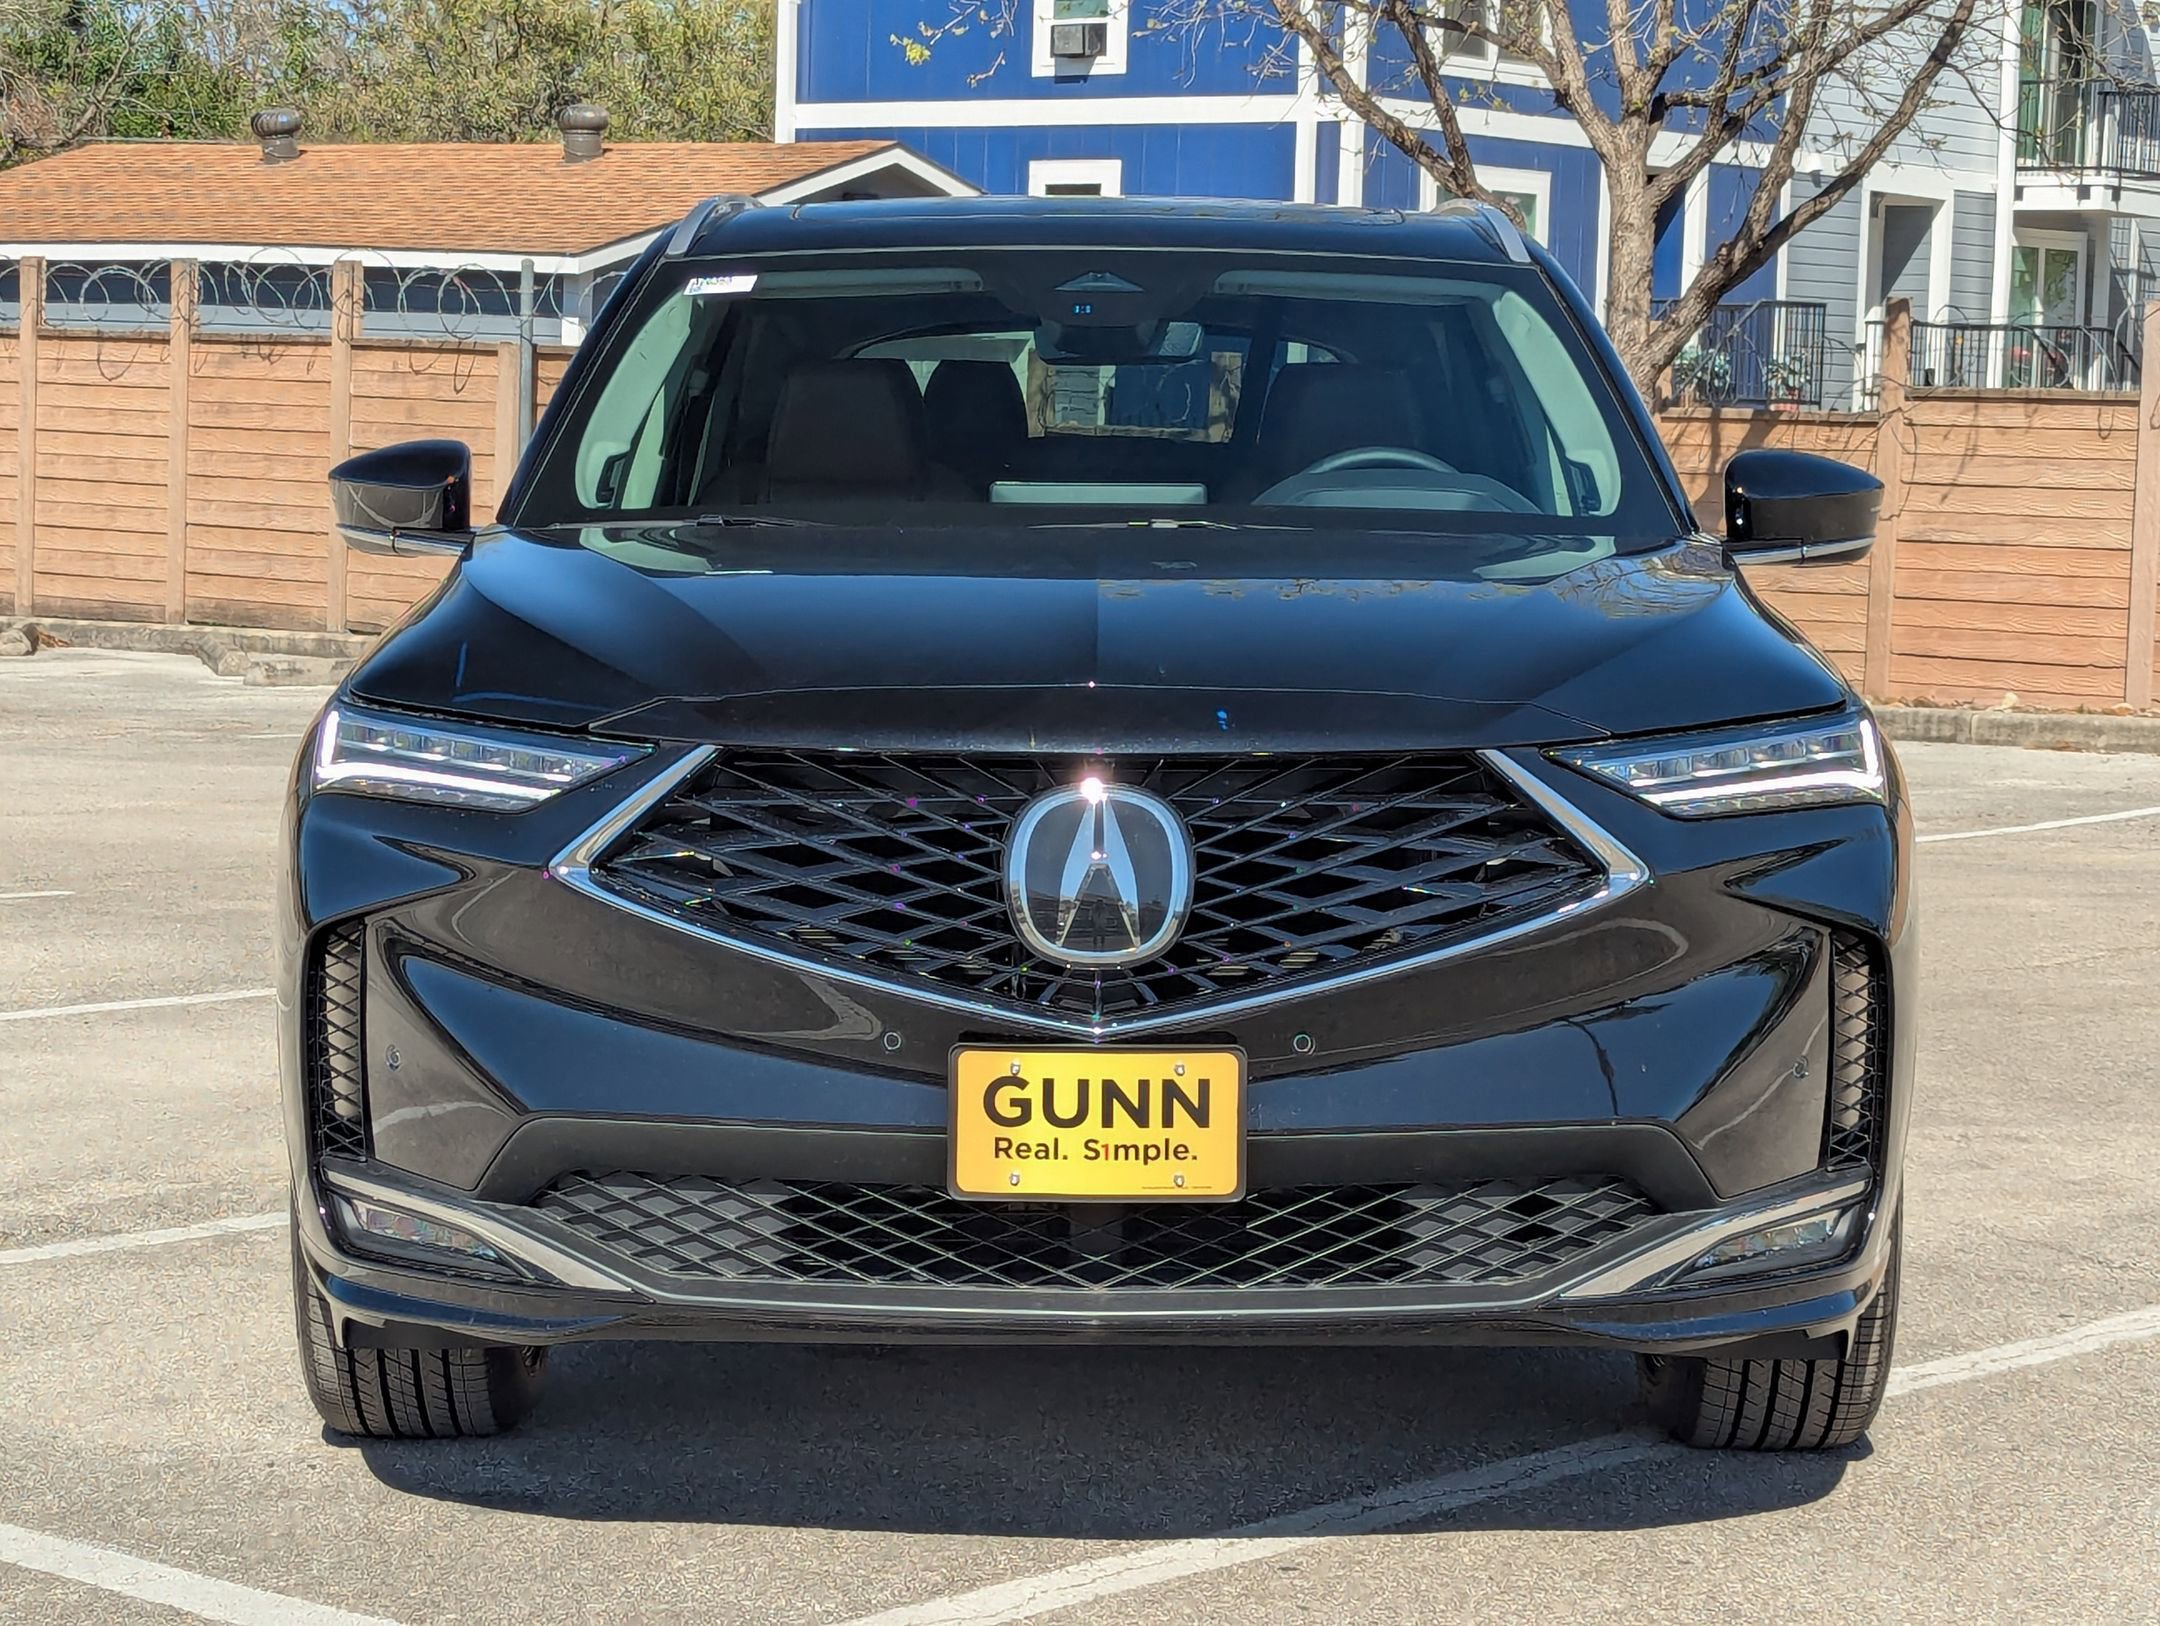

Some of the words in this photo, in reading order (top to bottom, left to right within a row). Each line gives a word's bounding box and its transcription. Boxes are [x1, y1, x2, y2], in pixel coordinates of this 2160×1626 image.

[983, 1075, 1210, 1129] GUNN
[994, 1136, 1068, 1161] Real.
[1083, 1138, 1198, 1165] S1mple.
